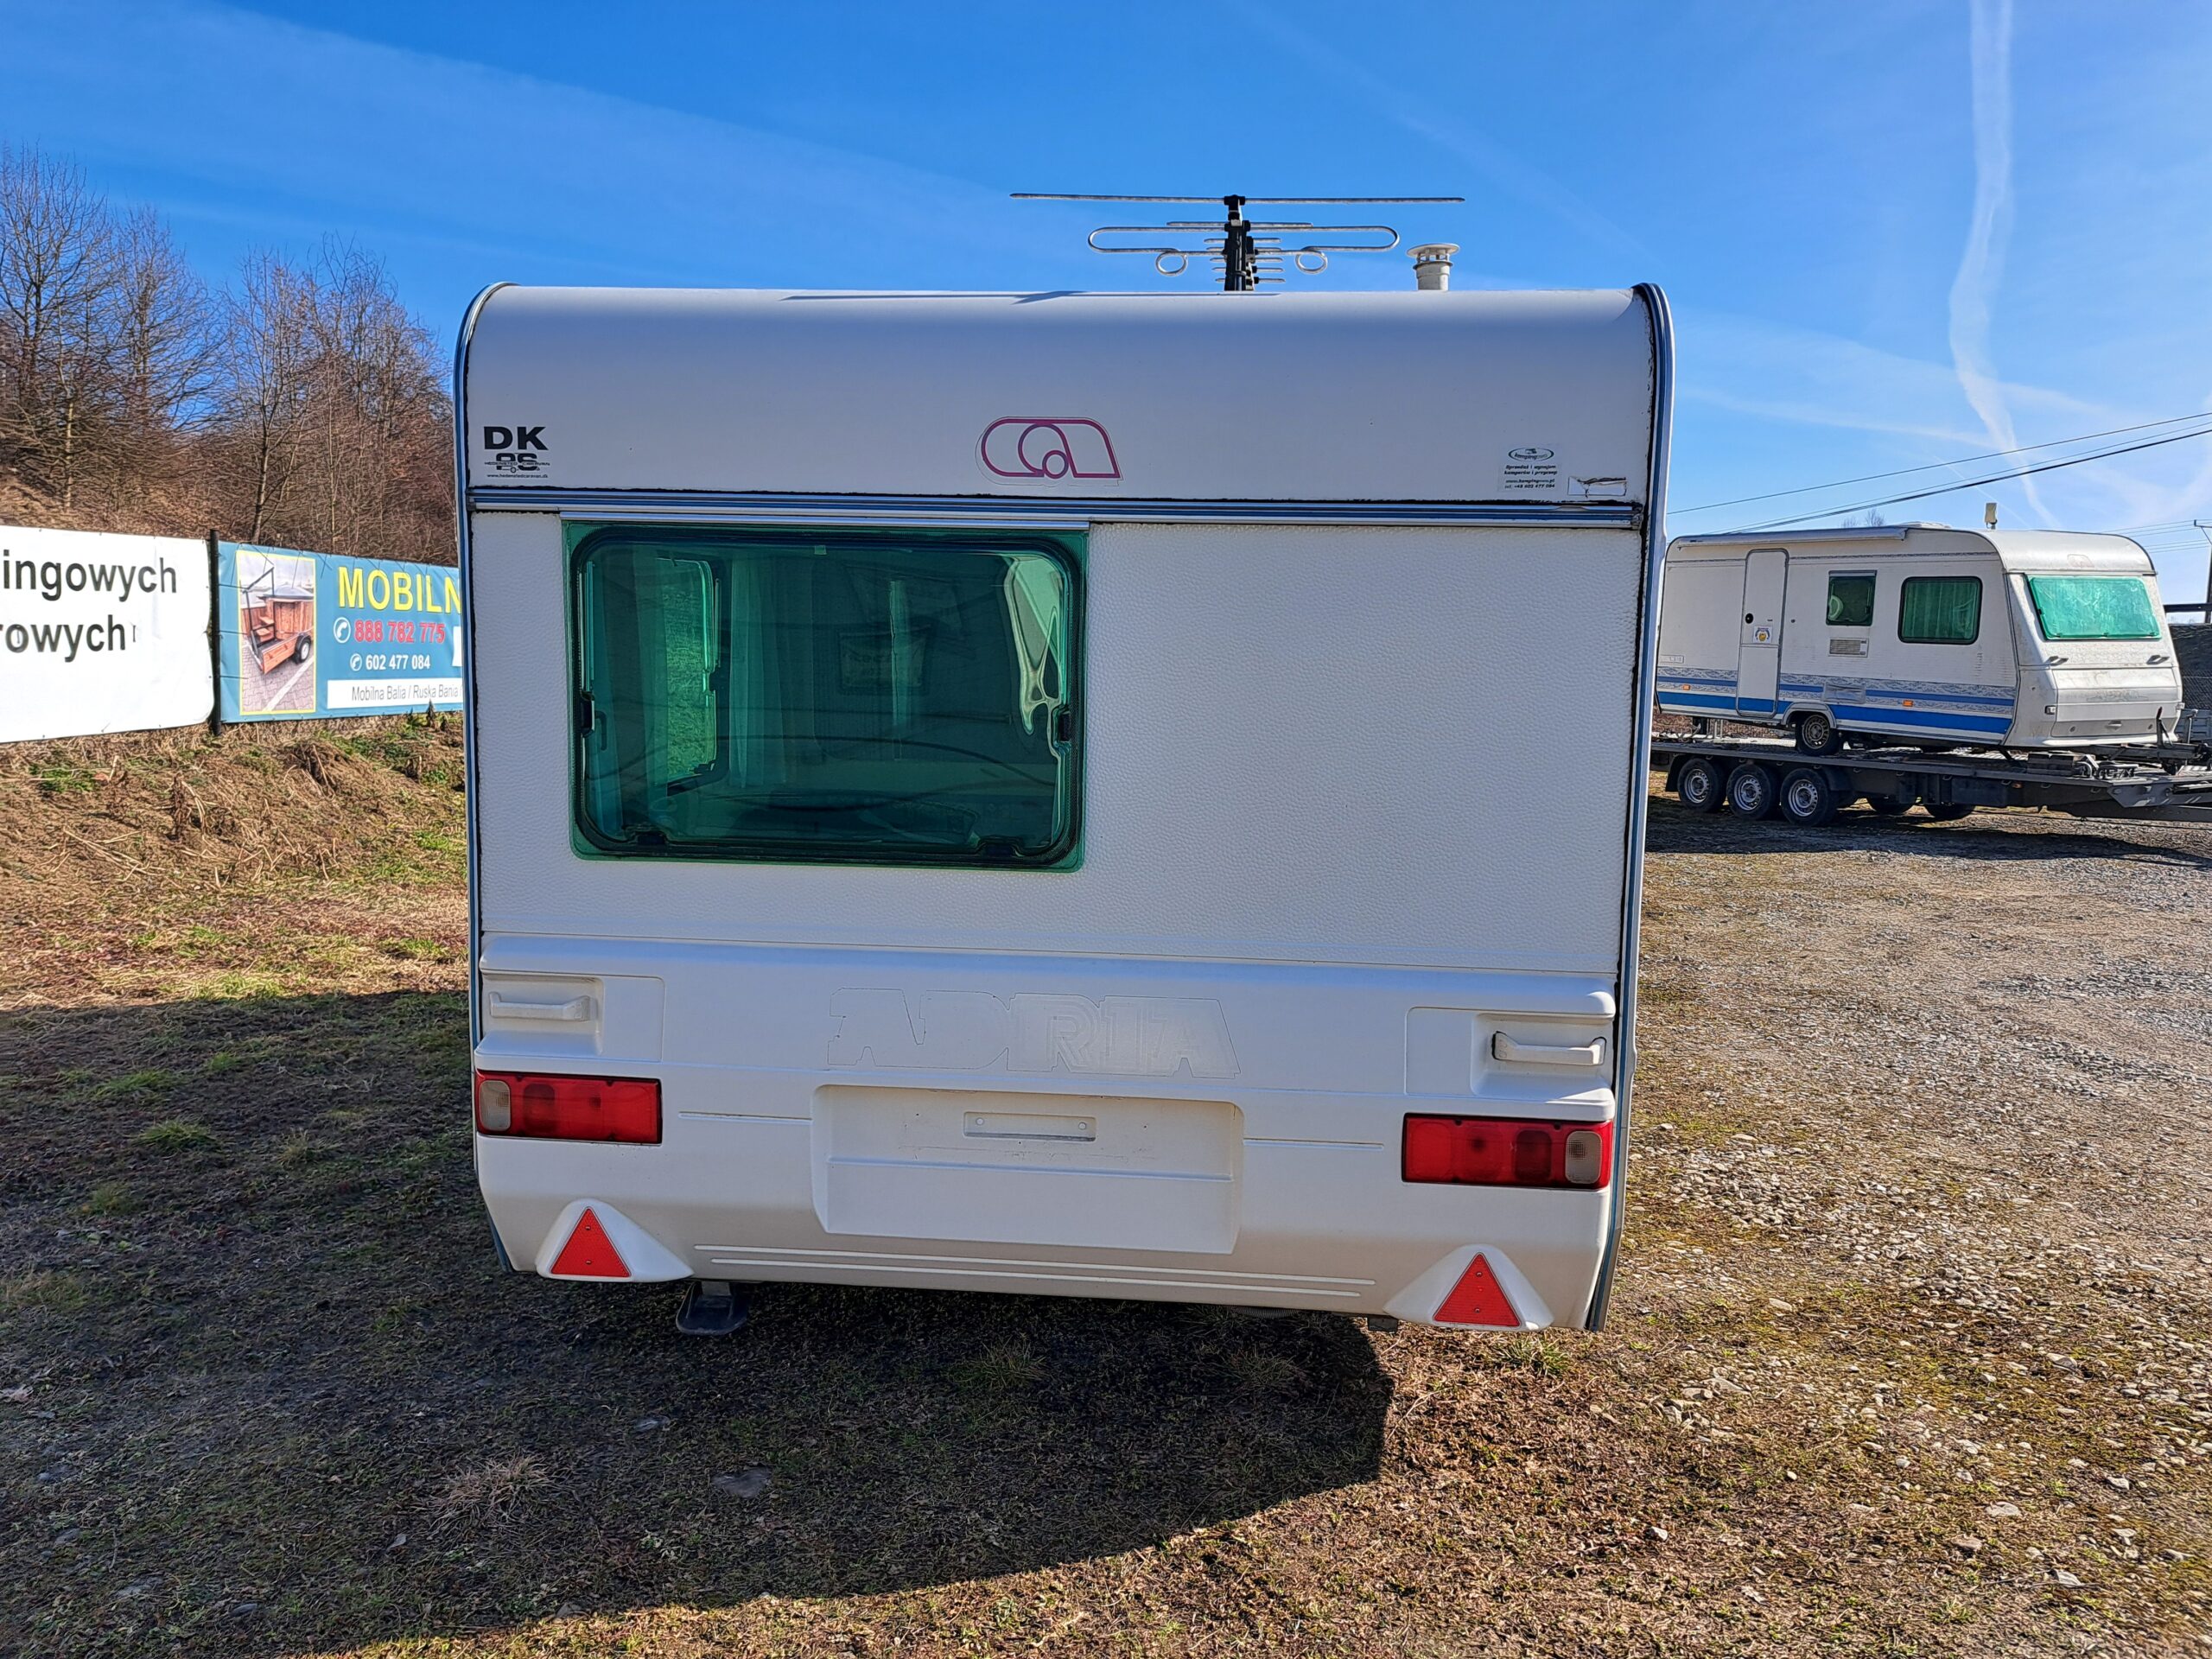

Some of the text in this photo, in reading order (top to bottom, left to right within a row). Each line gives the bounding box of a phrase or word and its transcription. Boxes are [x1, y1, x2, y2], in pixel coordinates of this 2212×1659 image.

[484, 426, 549, 450] DK
[3, 549, 176, 602] ingowych
[0, 614, 125, 663] owych
[354, 620, 445, 644] 888 782 775
[365, 654, 430, 670] 602 477 084
[352, 686, 384, 701] Mobilna
[387, 685, 406, 700] Balia
[413, 684, 436, 698] Ruska
[439, 683, 459, 697] Bania
[827, 988, 1241, 1079] ADRIA
